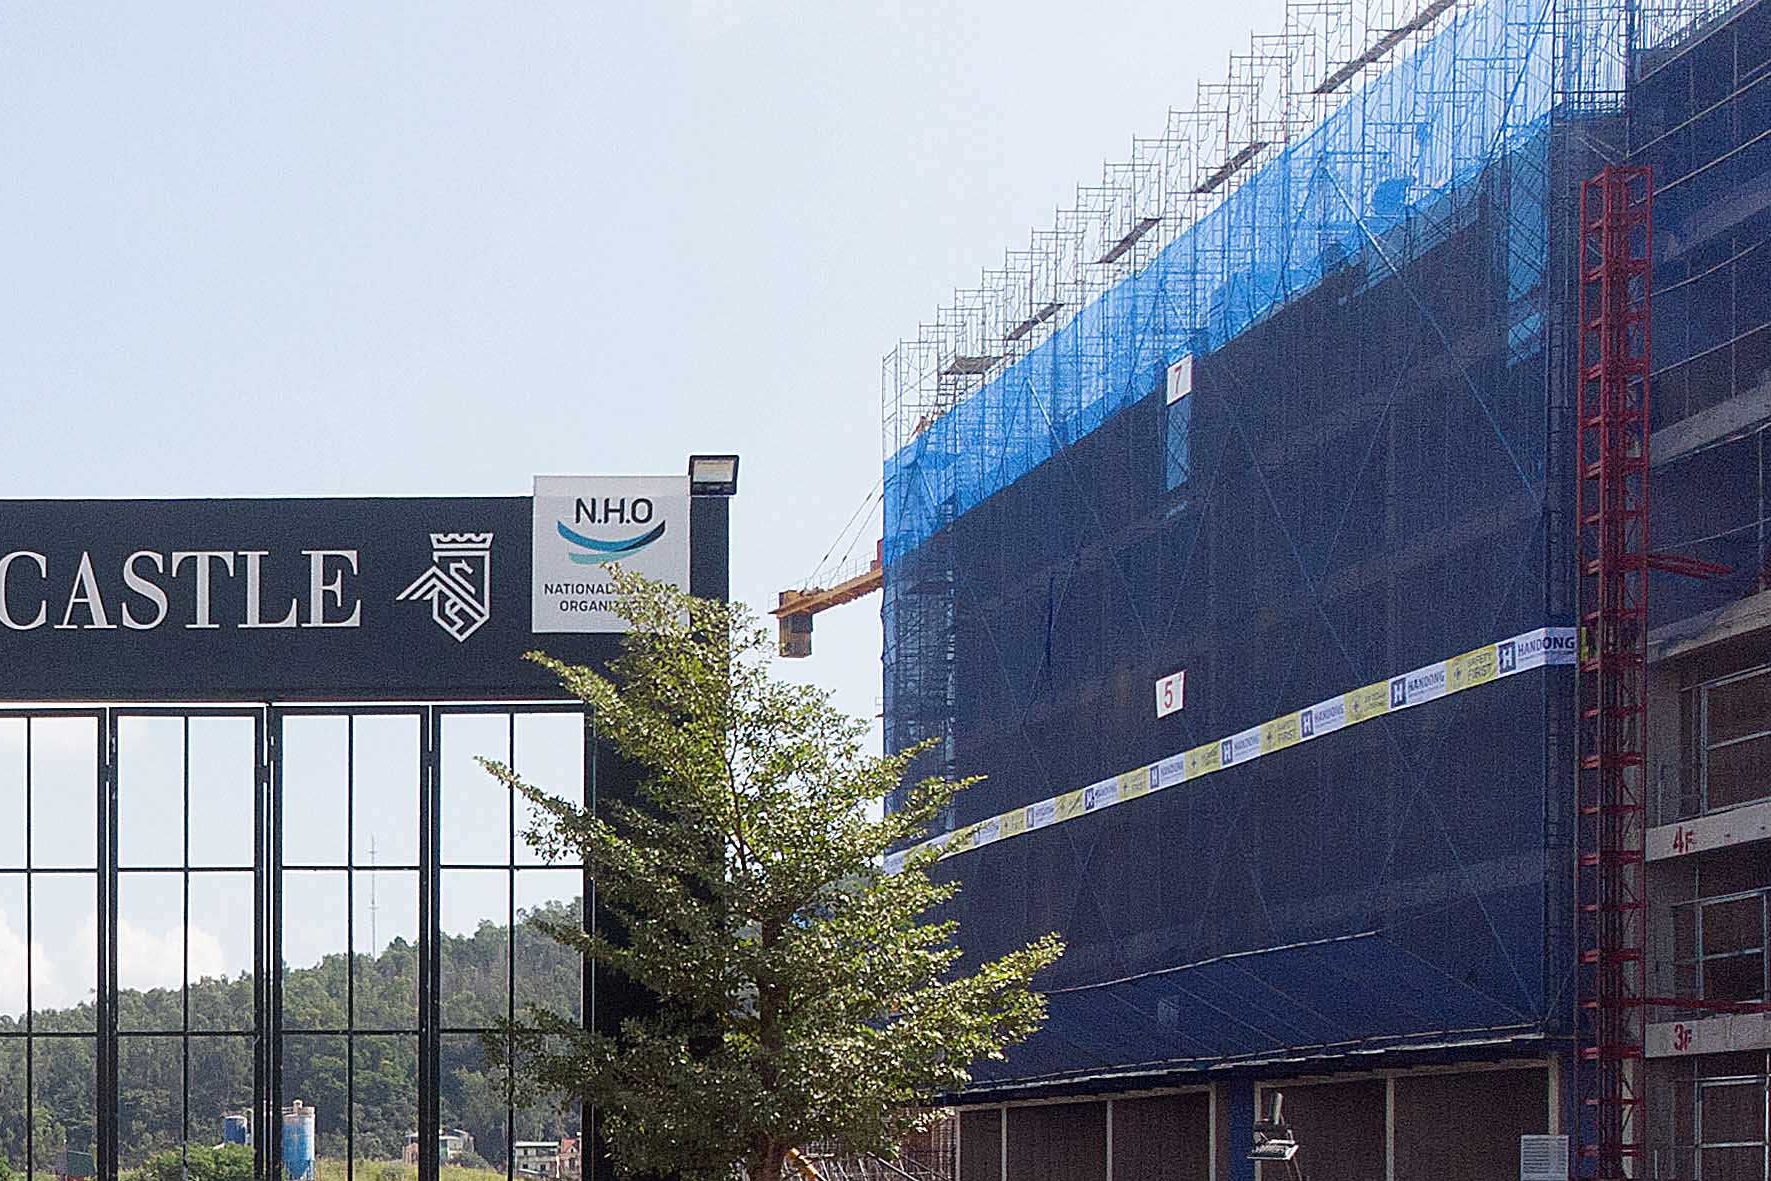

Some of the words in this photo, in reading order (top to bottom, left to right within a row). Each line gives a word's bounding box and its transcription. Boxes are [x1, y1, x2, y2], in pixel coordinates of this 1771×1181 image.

[1174, 365, 1182, 394] 7
[575, 498, 653, 524] N.H.O
[544, 583, 612, 595] NATIONAL
[1518, 636, 1575, 656] HANDONG
[1164, 680, 1173, 709] 5
[1408, 671, 1446, 692] HANDONG
[1672, 826, 1694, 853] 4F
[1673, 1023, 1693, 1052] 3F
